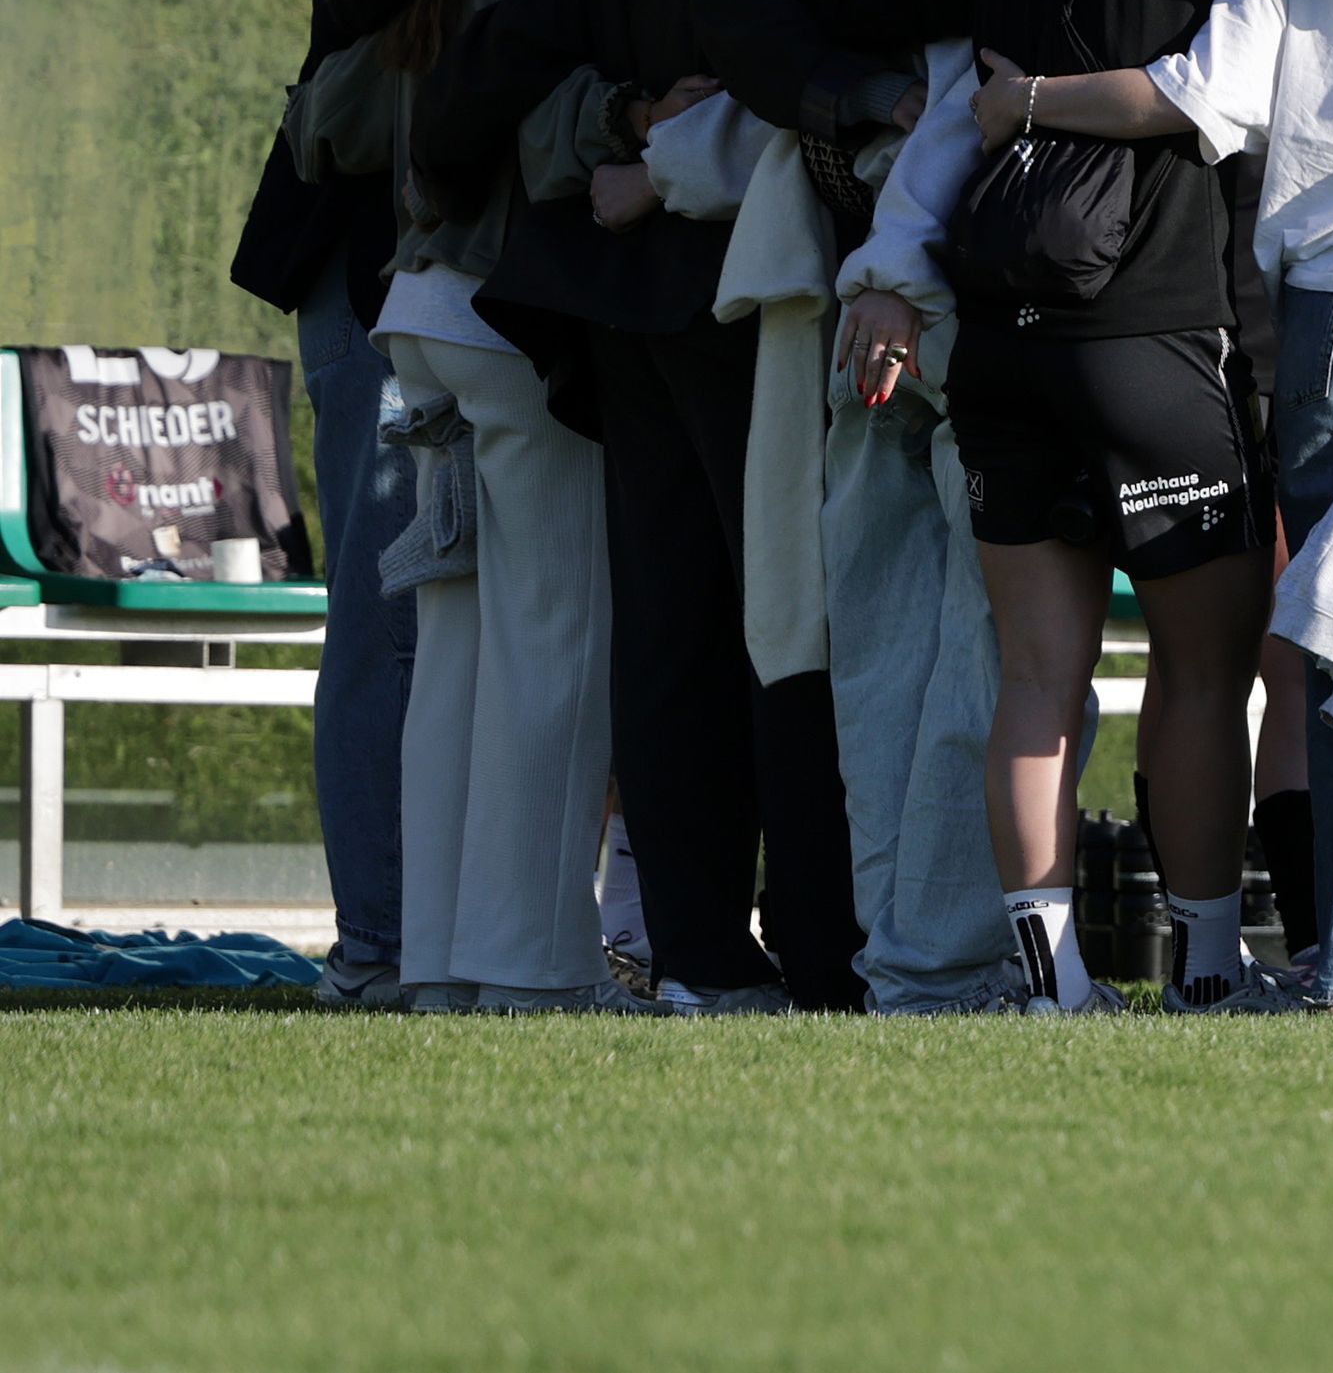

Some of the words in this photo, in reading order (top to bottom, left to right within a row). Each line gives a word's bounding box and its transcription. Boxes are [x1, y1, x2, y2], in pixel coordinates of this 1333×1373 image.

[76, 400, 238, 448] SCHIEDER
[1119, 473, 1200, 499] Autohaus
[1121, 480, 1229, 516] Neulengbach
